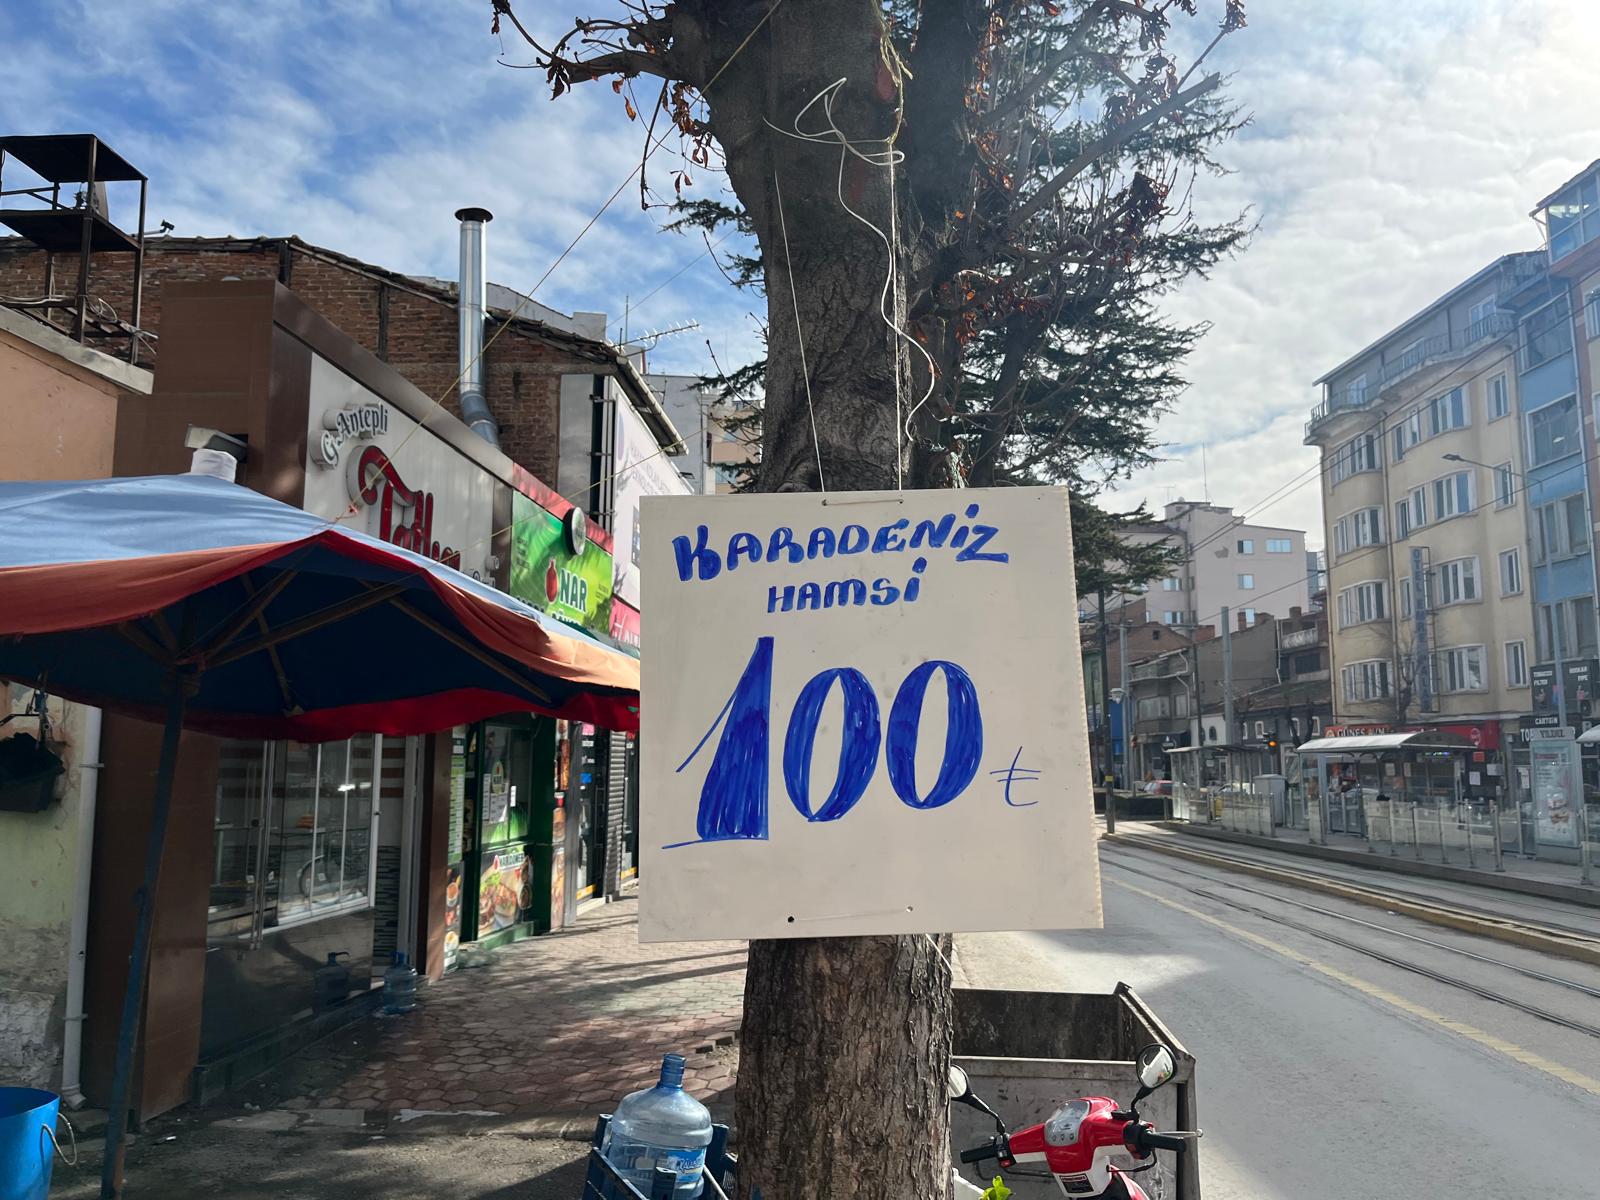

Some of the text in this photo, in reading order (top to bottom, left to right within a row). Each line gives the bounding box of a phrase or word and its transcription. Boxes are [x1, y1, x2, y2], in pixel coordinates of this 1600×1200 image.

[672, 503, 1010, 582] KARADENİZ
[560, 568, 588, 614] NAR
[767, 556, 928, 613] HAMSİ
